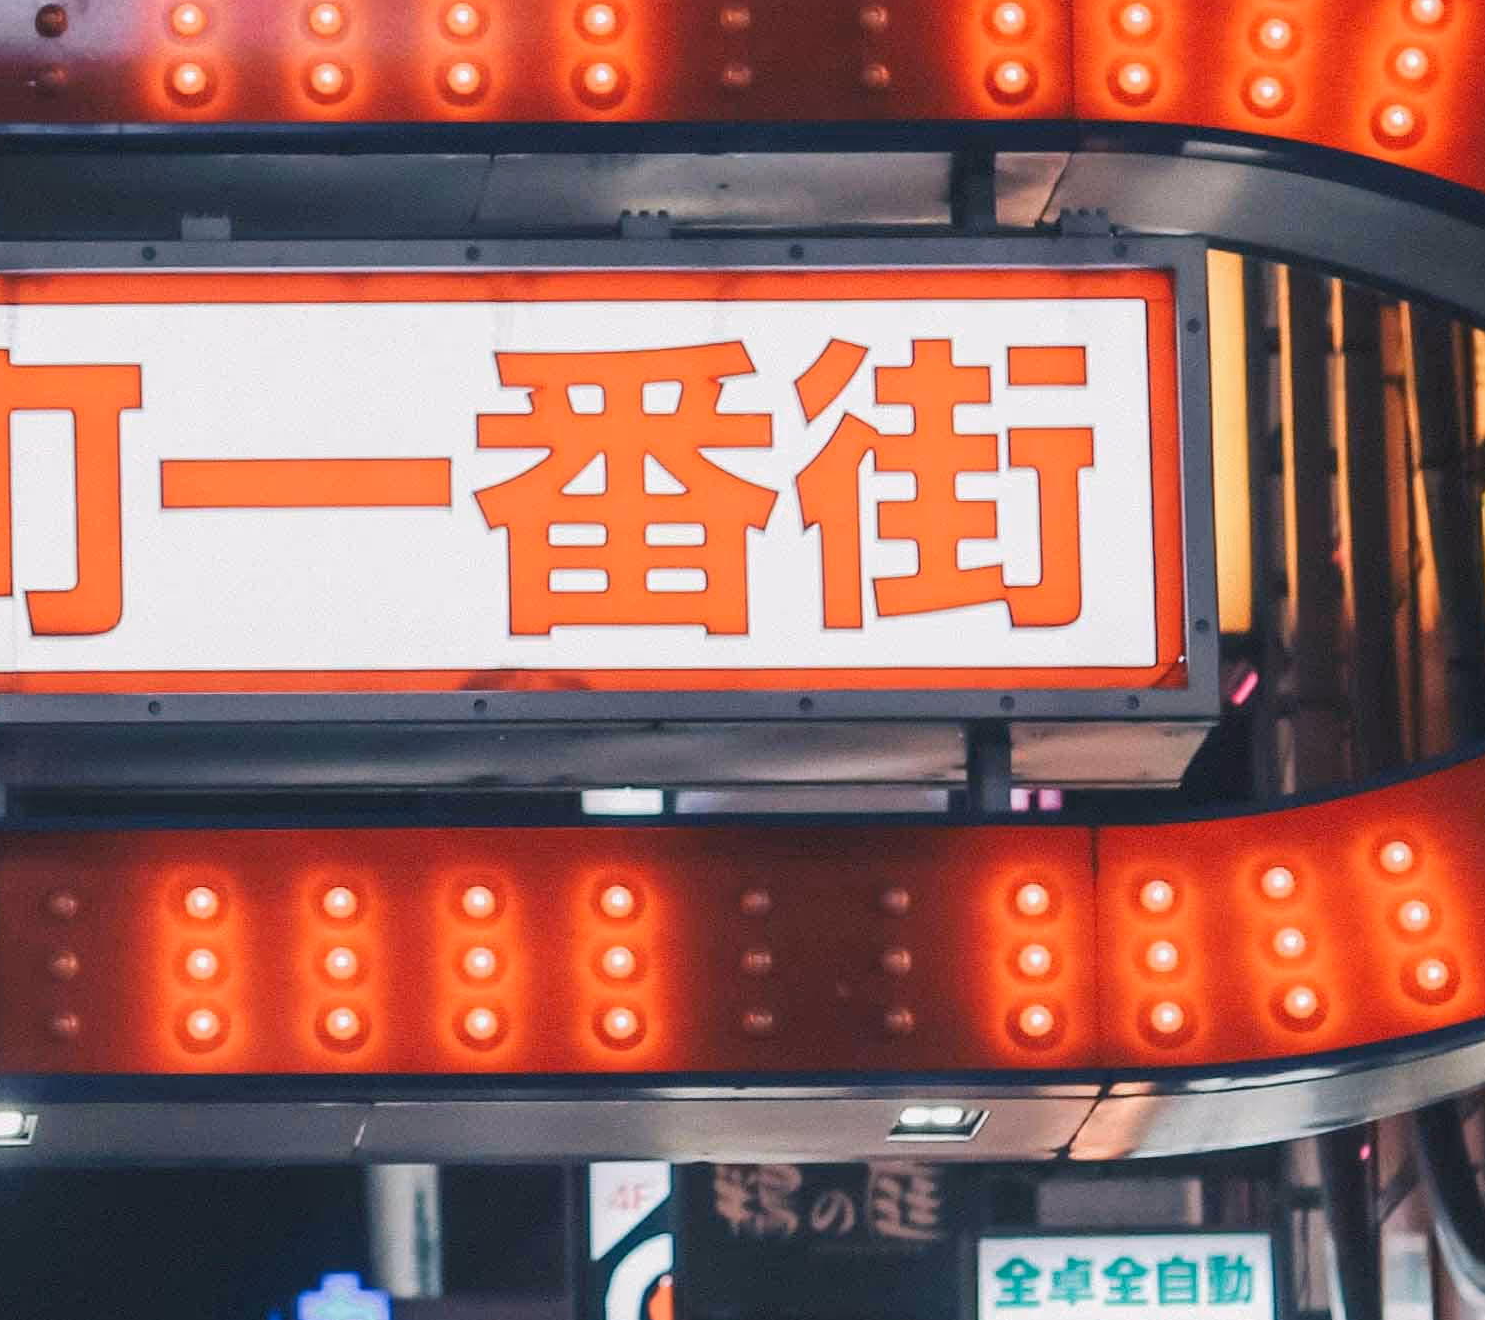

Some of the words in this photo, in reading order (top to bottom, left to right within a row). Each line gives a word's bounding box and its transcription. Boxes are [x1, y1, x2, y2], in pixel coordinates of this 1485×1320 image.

[993, 1255, 1254, 1309] 全卓全自動
